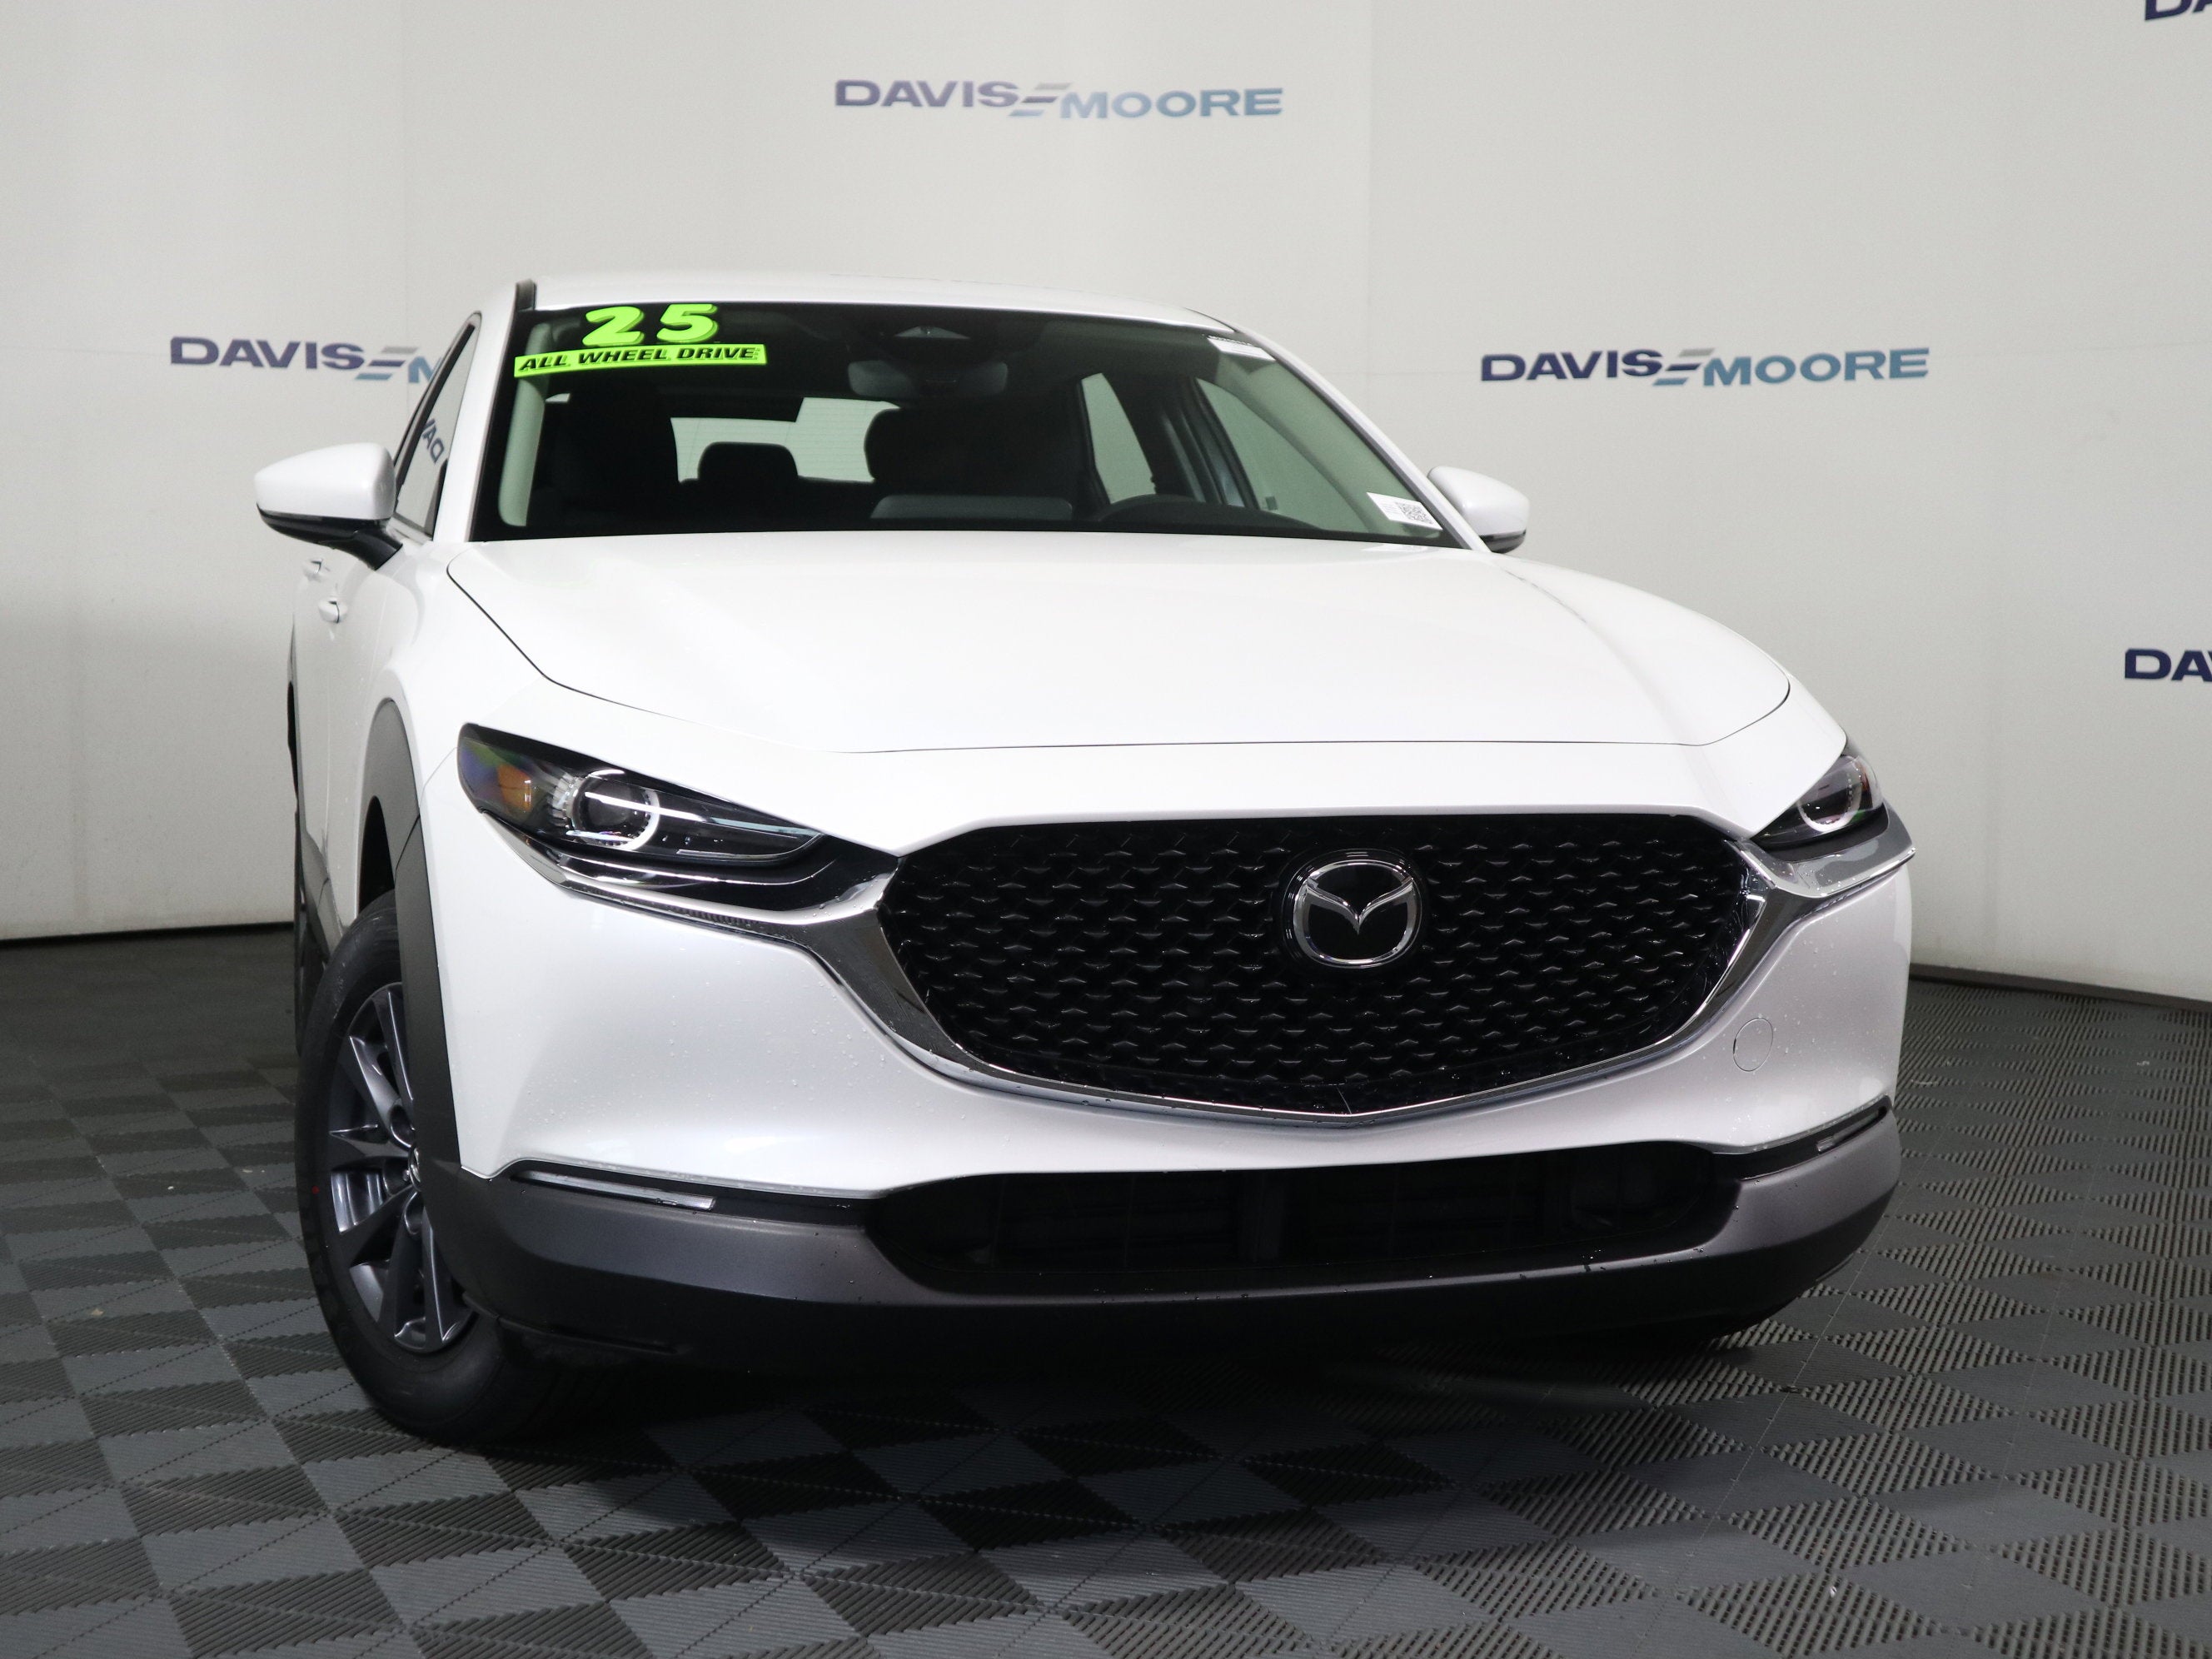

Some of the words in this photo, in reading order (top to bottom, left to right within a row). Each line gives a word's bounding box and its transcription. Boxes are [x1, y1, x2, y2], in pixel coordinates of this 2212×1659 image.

[835, 79, 1019, 107] DAVIS
[1060, 87, 1283, 119] MOORE
[583, 303, 720, 346] 25
[170, 336, 365, 370] DAVIS
[517, 354, 569, 372] ALL
[578, 347, 668, 365] WHEEL
[676, 346, 759, 360] DRIVE
[1481, 348, 1664, 381] DAVIS
[1703, 347, 1930, 386] MOORE
[2125, 648, 2212, 683] DA
